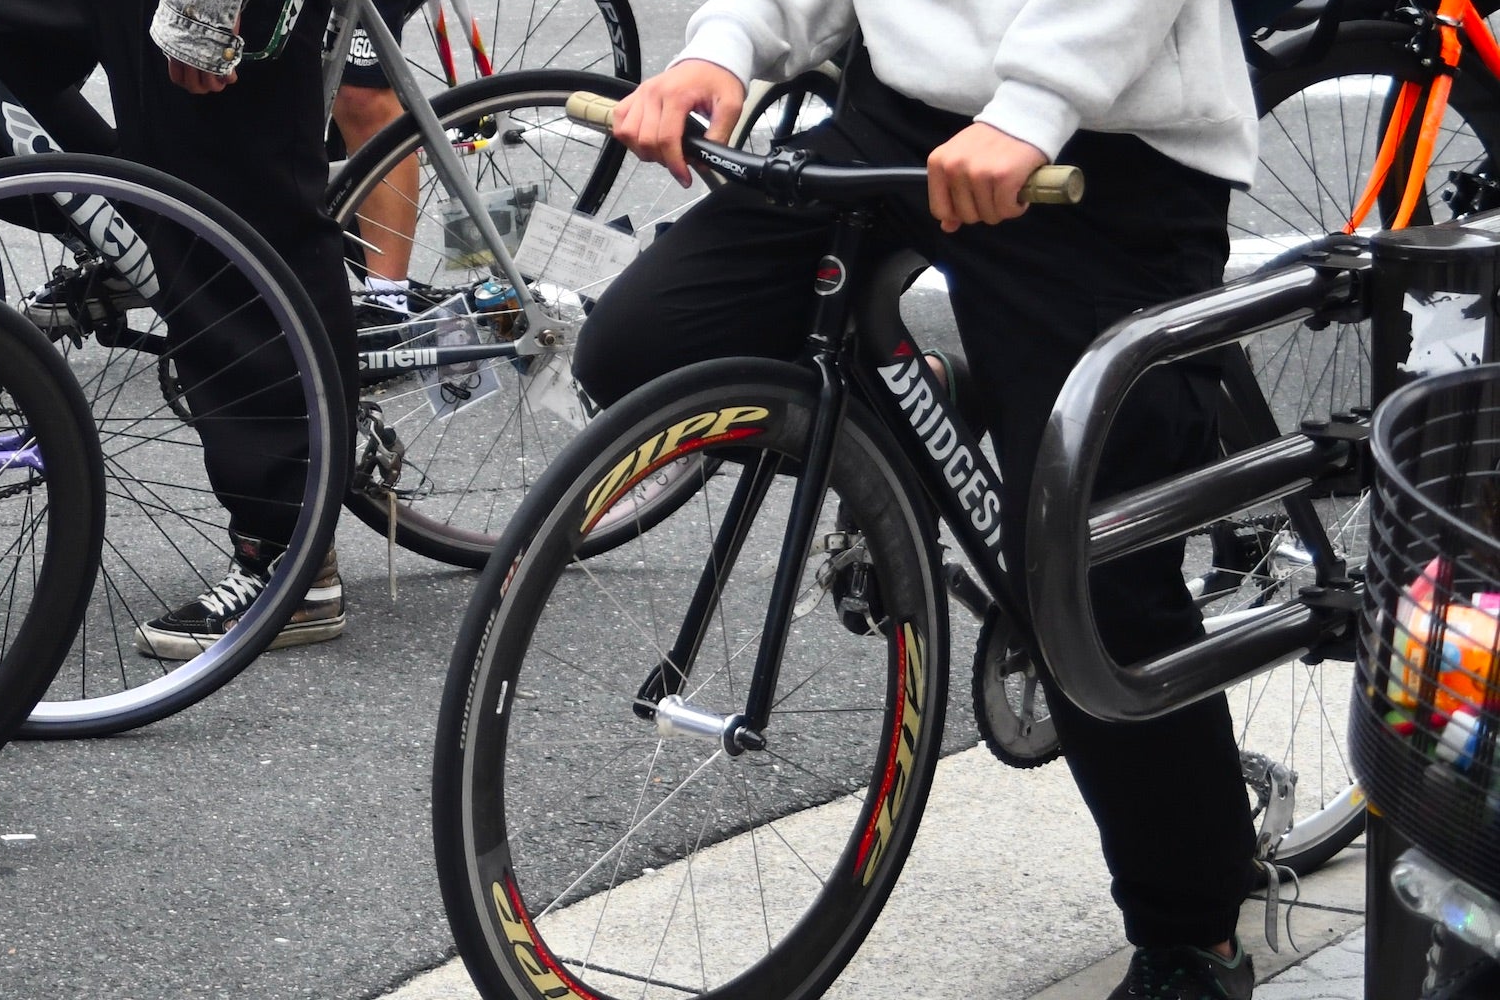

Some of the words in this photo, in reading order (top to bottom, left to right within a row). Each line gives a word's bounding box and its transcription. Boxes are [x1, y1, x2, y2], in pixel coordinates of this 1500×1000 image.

[700, 149, 746, 175] THOMSON
[580, 405, 770, 533] ZIPP
[877, 357, 1007, 573] BRIDGES
[863, 621, 927, 887] ZIPP
